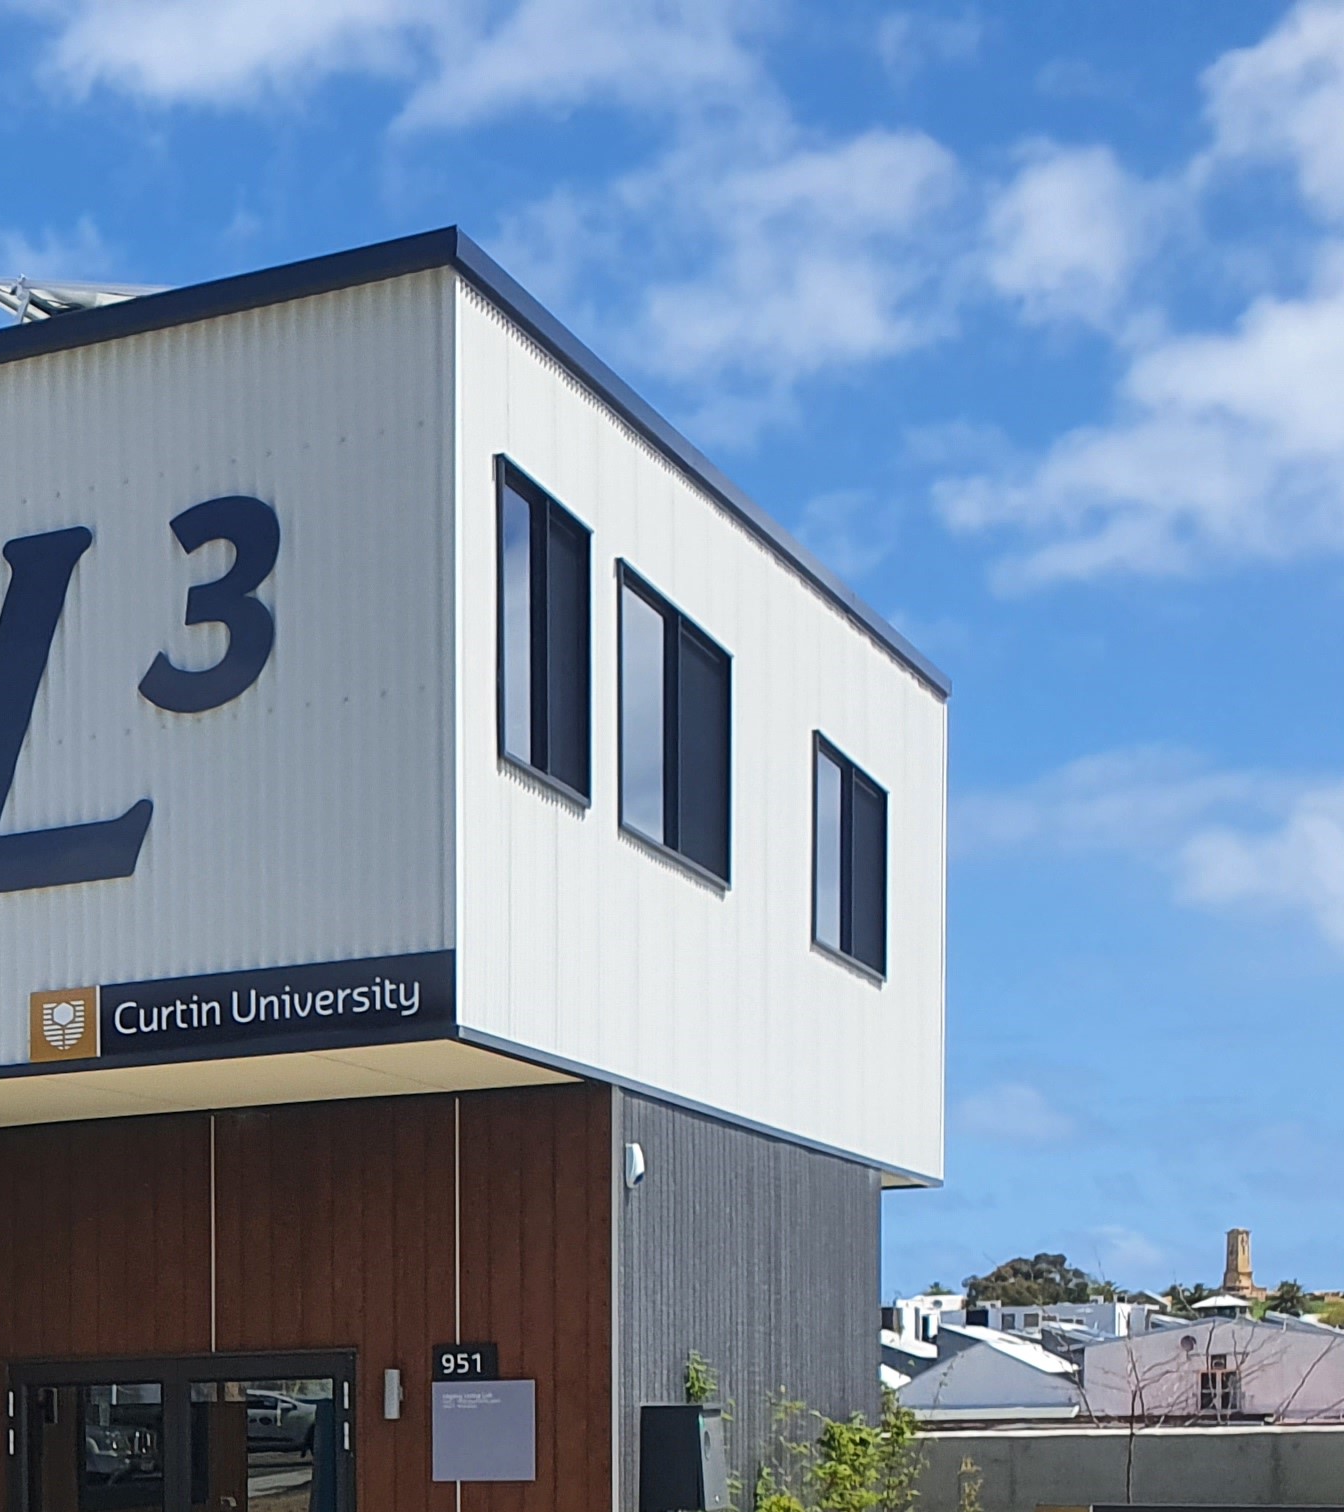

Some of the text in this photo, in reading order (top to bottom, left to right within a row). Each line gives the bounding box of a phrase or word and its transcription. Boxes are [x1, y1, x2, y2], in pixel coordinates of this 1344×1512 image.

[113, 976, 421, 1036] Curtin University
[441, 1353, 483, 1375] 951
